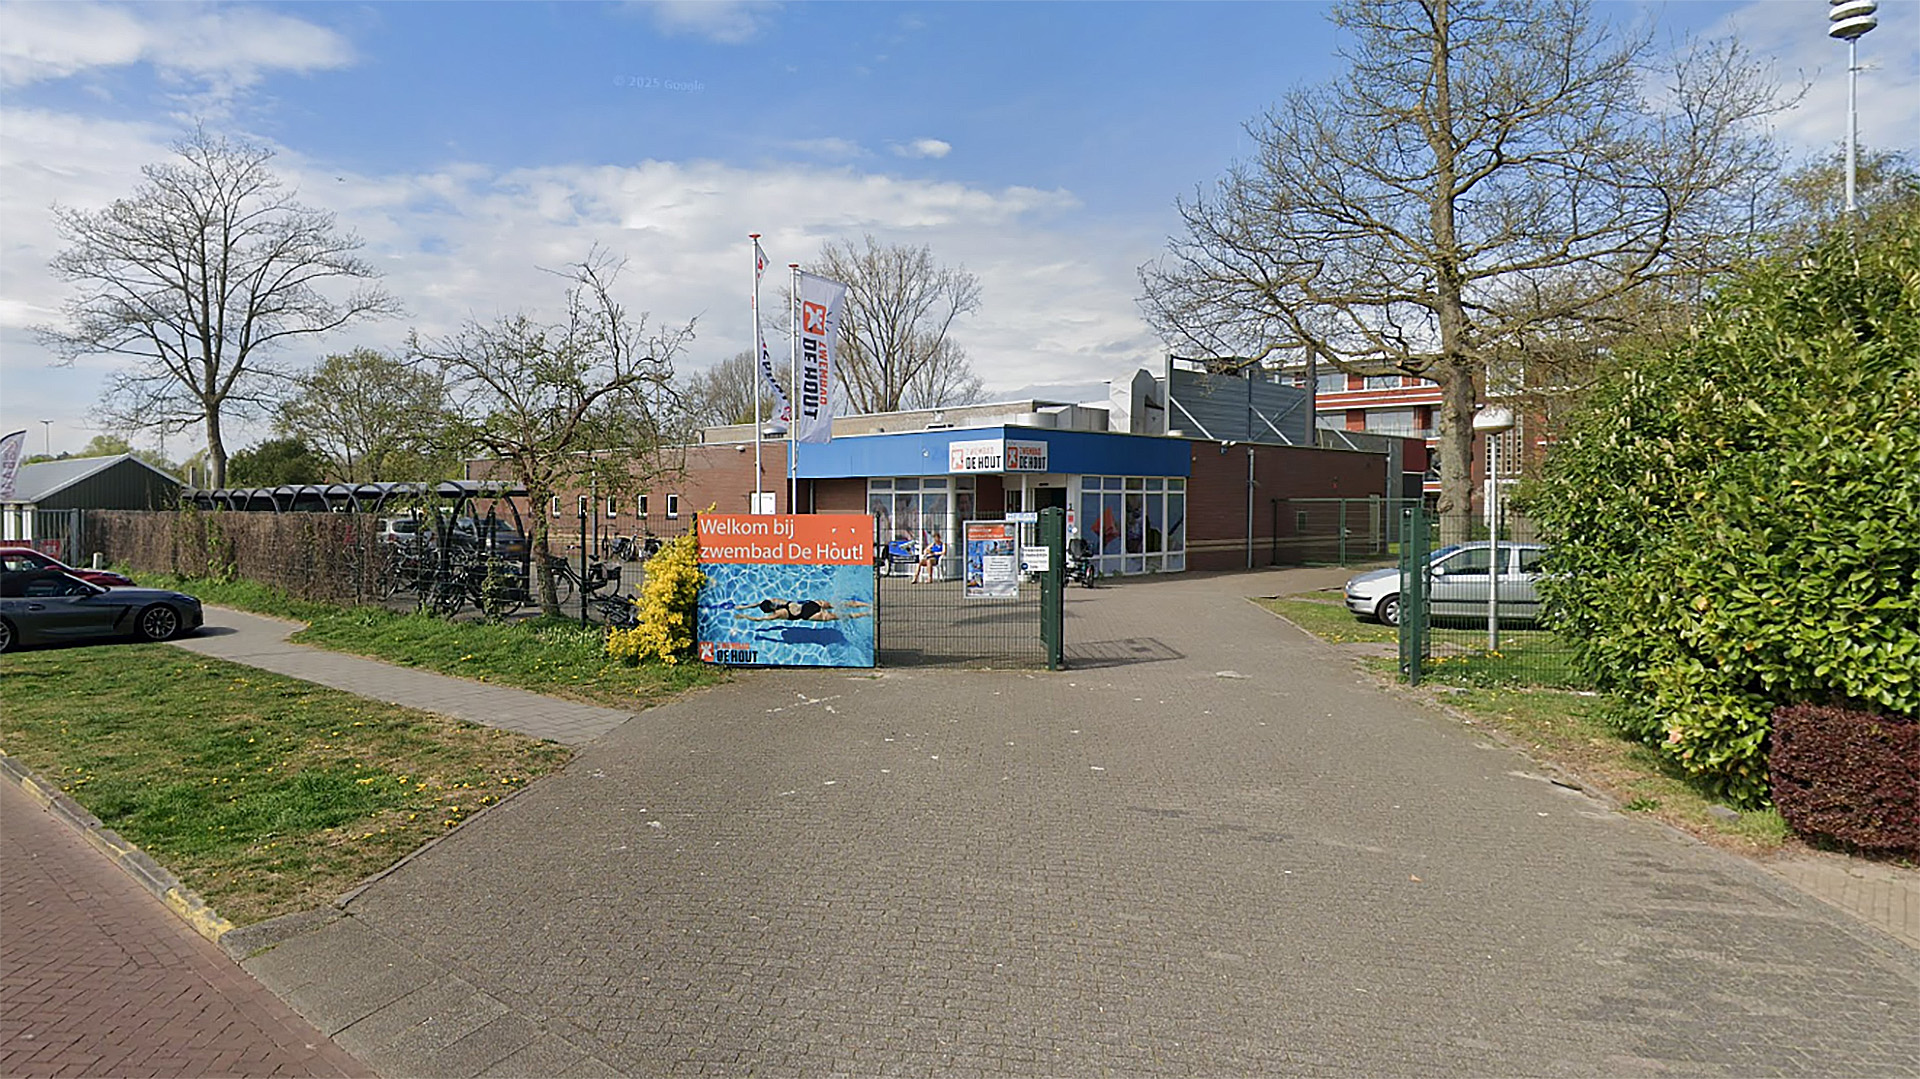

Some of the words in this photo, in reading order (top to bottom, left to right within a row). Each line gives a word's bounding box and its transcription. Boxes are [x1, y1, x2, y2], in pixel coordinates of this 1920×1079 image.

[803, 337, 817, 364] DE
[818, 341, 829, 406] ZWEMBAD
[803, 366, 819, 421] HOUT
[966, 457, 976, 469] DE
[978, 456, 1001, 469] HOUT
[1019, 456, 1028, 469] DE
[700, 519, 768, 535] Welkom
[774, 518, 795, 540] bij
[700, 543, 783, 559] zwembad
[788, 543, 812, 559] De
[816, 543, 863, 560] Hout!
[716, 650, 729, 662] DE
[731, 650, 758, 663] HOUT
